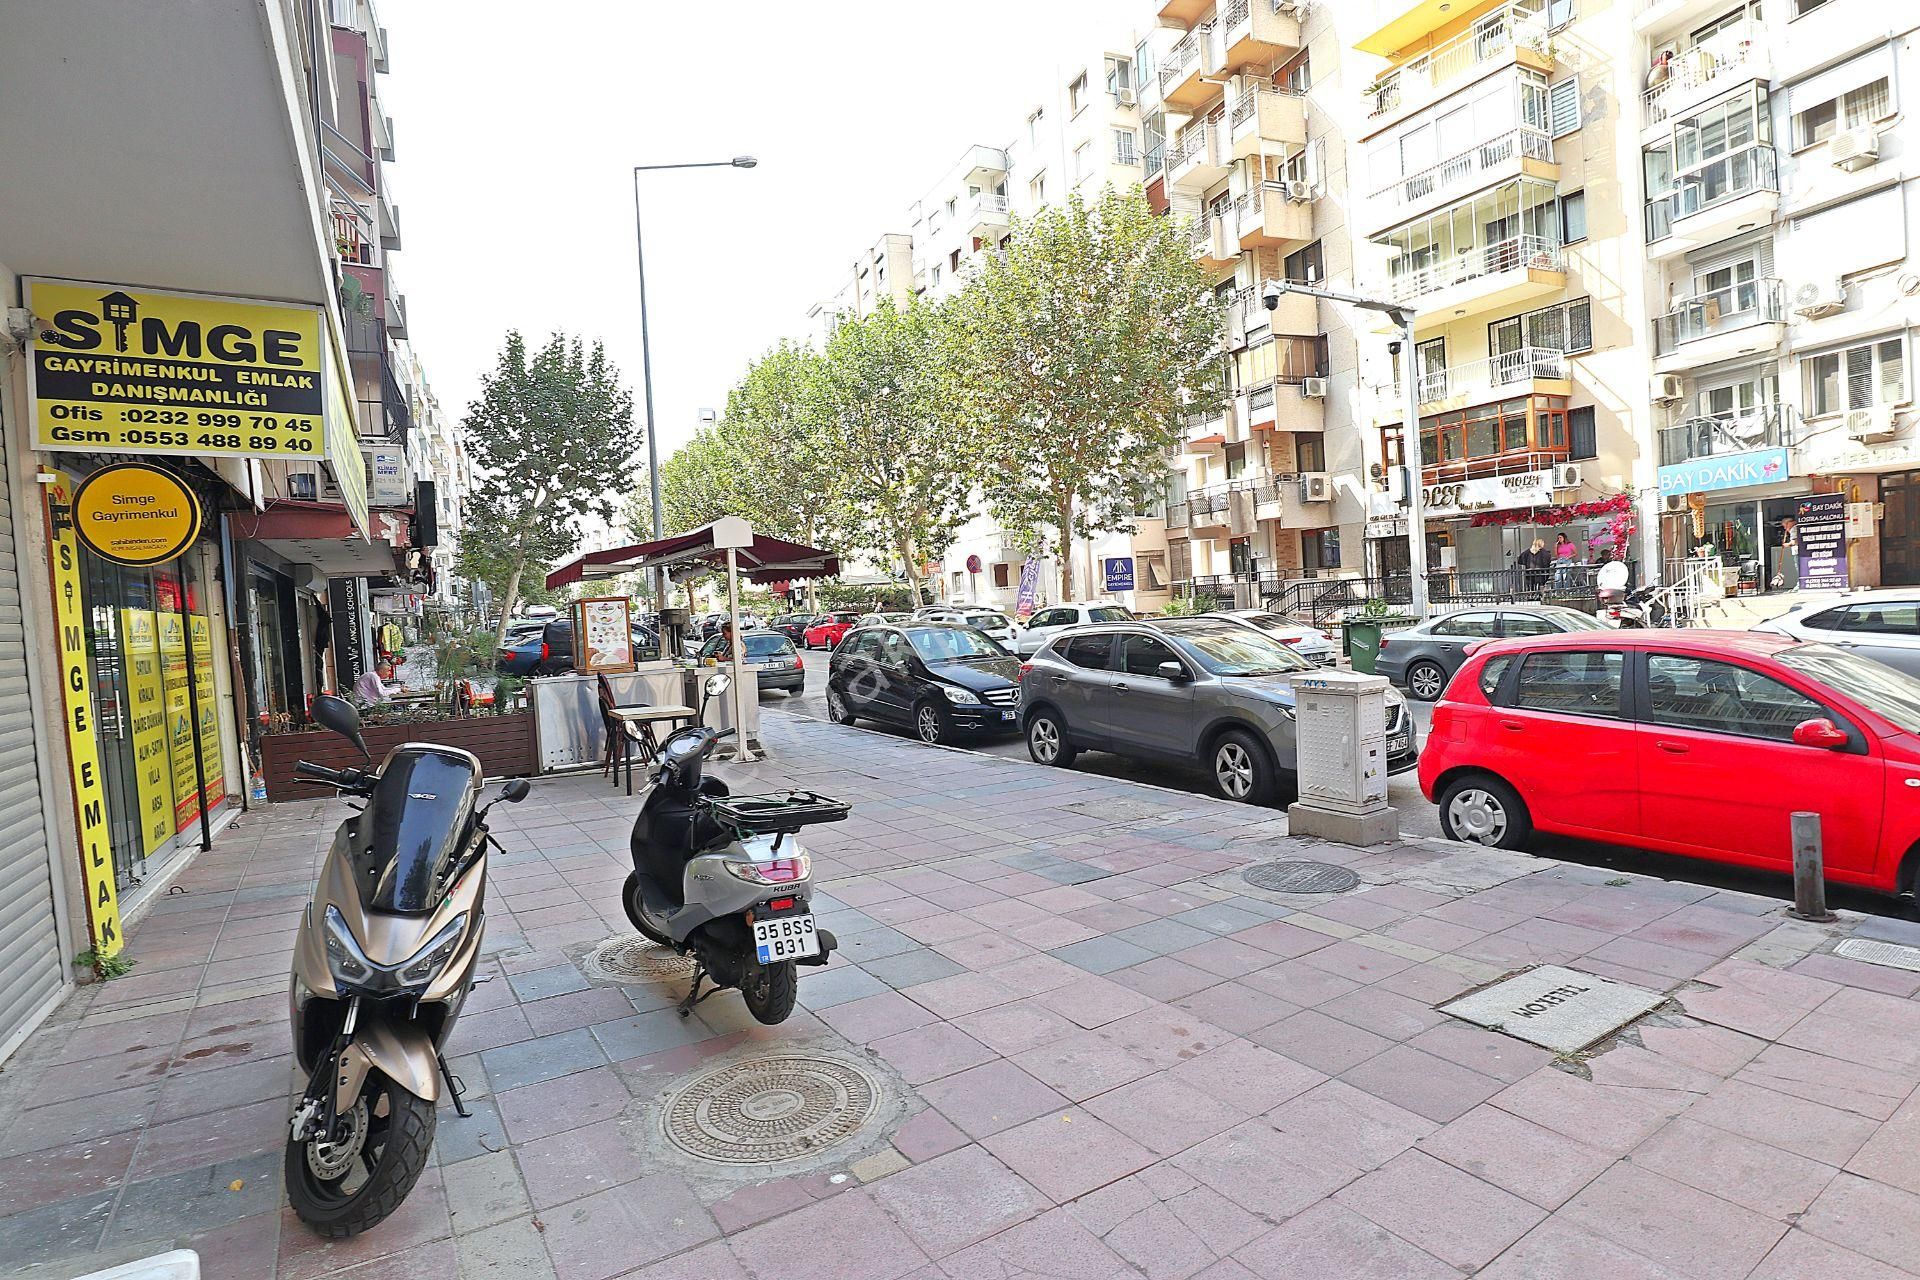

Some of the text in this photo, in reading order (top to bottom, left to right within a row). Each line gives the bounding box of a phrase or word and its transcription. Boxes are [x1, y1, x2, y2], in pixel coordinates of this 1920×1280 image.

[44, 356, 314, 390] GAYRİMENKUL EMLAK
[91, 382, 268, 407] DANIŞMANLIĞI
[50, 405, 312, 433] Ofis :0232 999 70 45
[51, 427, 312, 452] Gsm :0553 488 89 40
[1660, 461, 1758, 491] BAY DAKİK
[112, 495, 156, 506] Simge
[1812, 503, 1824, 511] BAY
[92, 508, 178, 523] Gayrimenkul
[111, 537, 168, 546] sahibinden.com
[345, 579, 355, 610] SCHOOLS
[82, 760, 117, 946] EMLAK
[773, 883, 801, 893] KUBA
[757, 919, 813, 941] 35 BSS
[775, 938, 805, 956] 831
[1511, 984, 1592, 1019] TELEKOM
